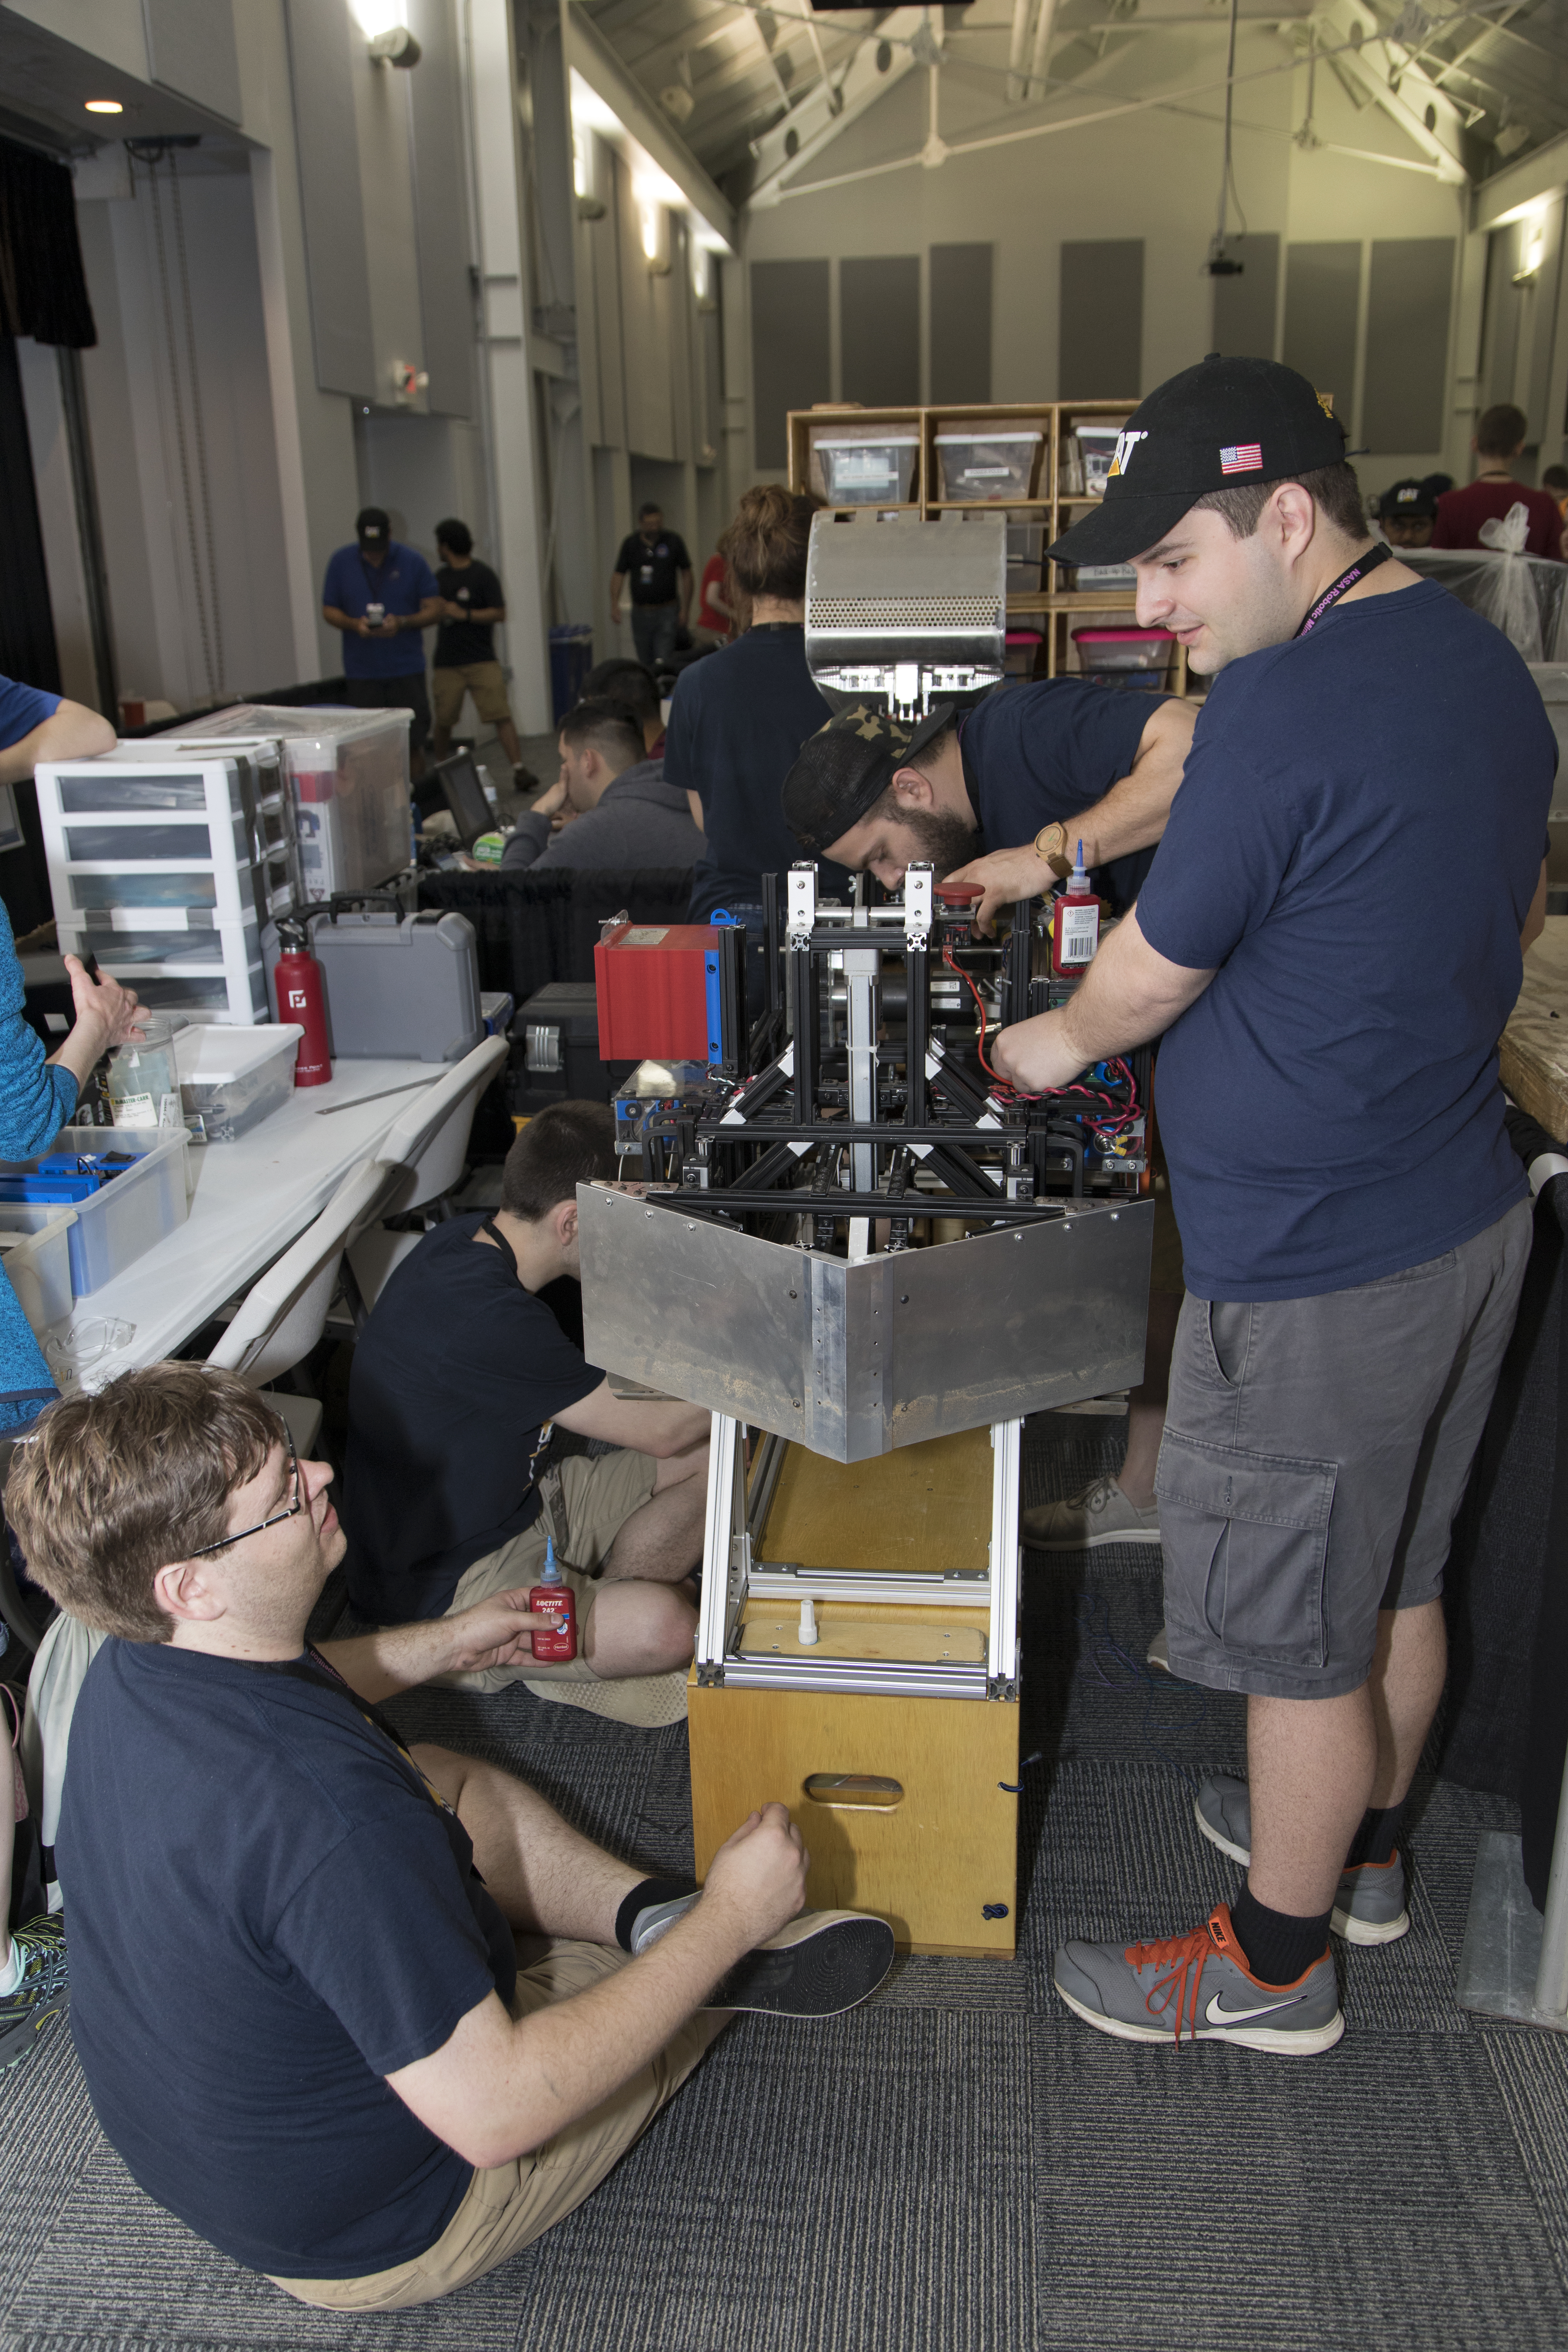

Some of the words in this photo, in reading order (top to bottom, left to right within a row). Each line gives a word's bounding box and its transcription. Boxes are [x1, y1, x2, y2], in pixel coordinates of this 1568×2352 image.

[1336, 568, 1361, 589] NASA
[1311, 588, 1340, 619] Robotic
[310, 1650, 346, 1685] competition
[1211, 1922, 1227, 1942] NIKE
[15, 2046, 23, 2054] GEL
